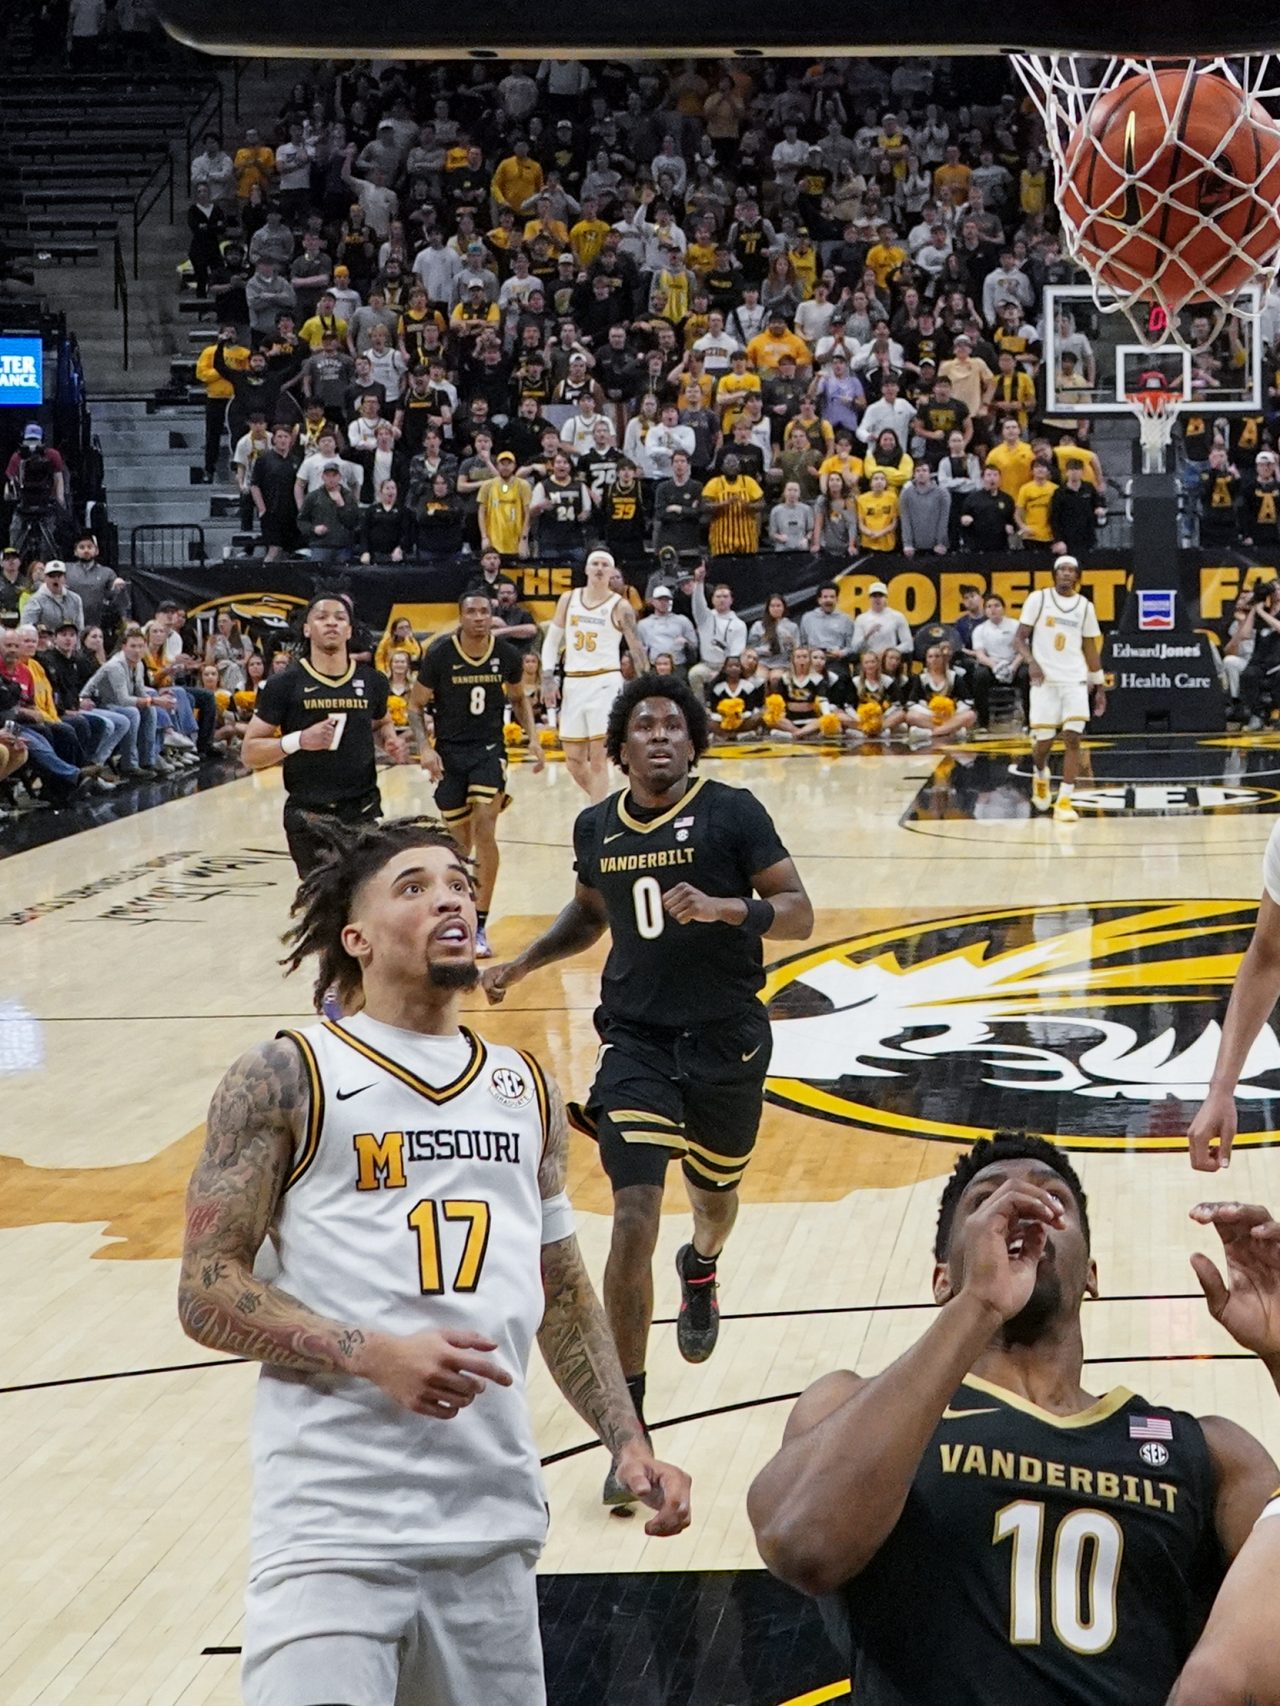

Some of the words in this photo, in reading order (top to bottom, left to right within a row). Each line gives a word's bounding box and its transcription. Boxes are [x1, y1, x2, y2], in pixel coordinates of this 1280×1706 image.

[612, 503, 636, 520] 39
[452, 673, 502, 685] VANDERBILT
[1121, 672, 1171, 688] Health
[1174, 672, 1211, 688] Care
[303, 698, 369, 710] VANDERBILT
[469, 686, 486, 715] 8
[327, 713, 347, 750] 7
[600, 847, 695, 873] VANDERBILT
[632, 875, 665, 940] 0
[492, 1068, 525, 1098] SEC
[353, 1129, 521, 1192] MISSOURI
[407, 1199, 492, 1296] 17
[1140, 1442, 1168, 1465] SEC
[939, 1443, 1178, 1514] VANDERBILT
[992, 1499, 1125, 1656] 10
